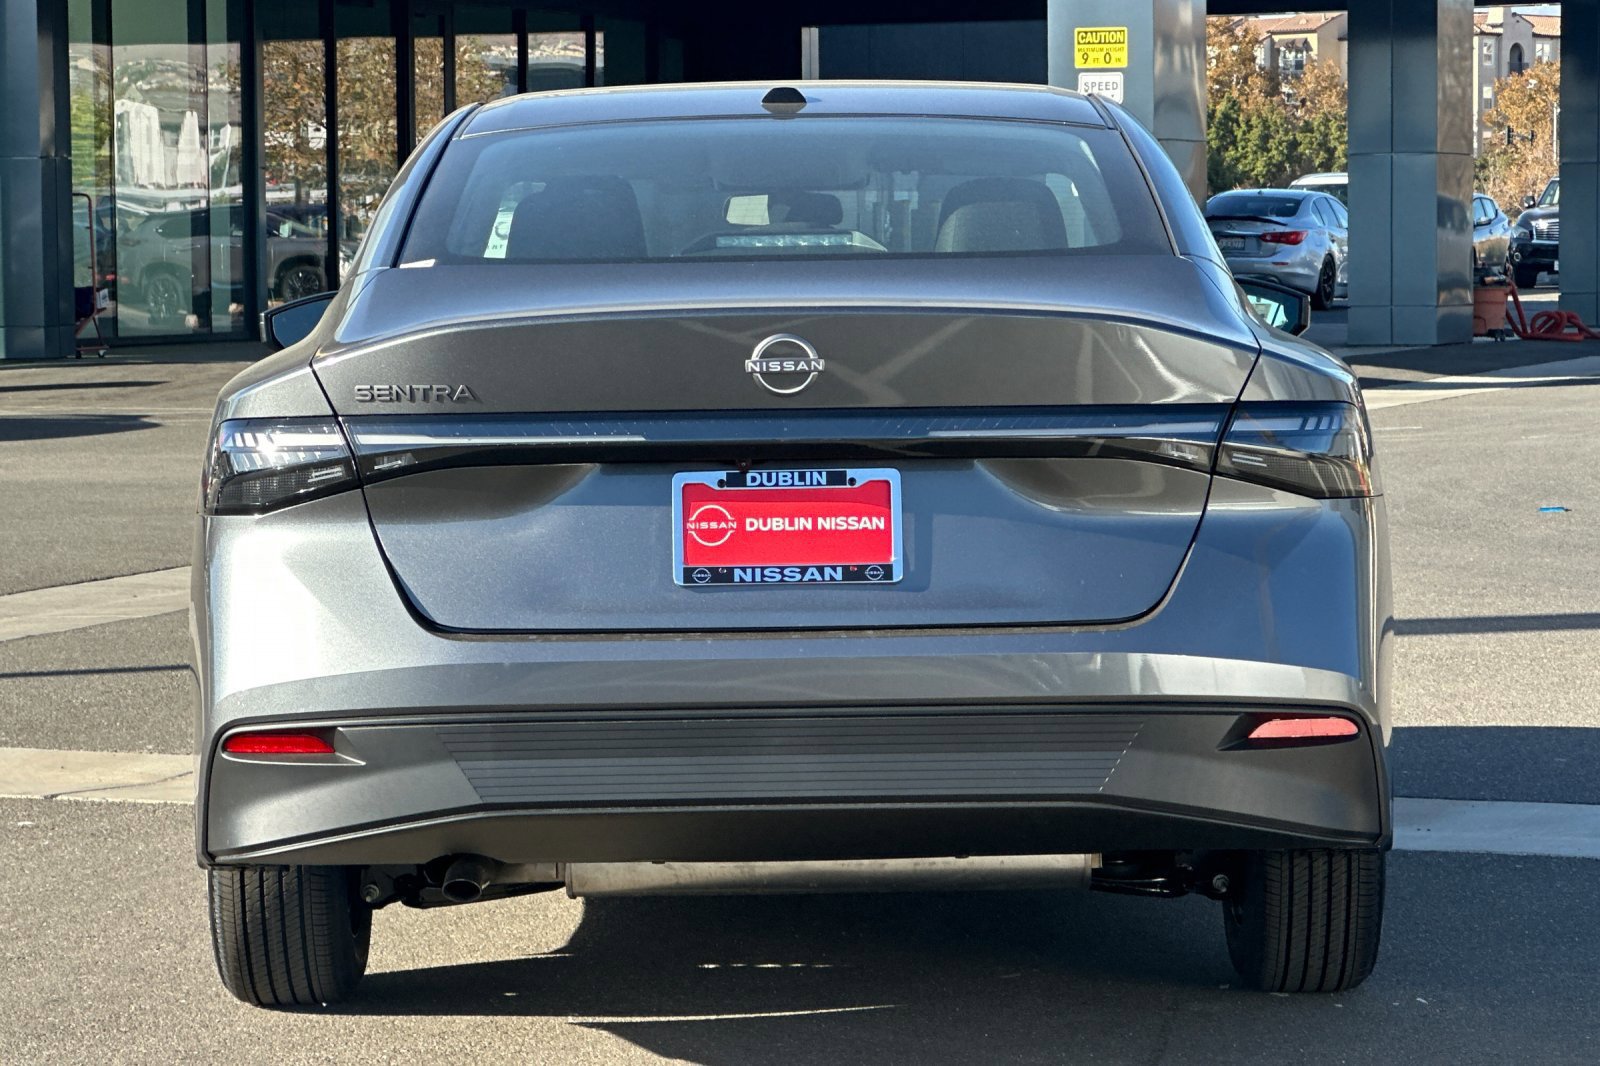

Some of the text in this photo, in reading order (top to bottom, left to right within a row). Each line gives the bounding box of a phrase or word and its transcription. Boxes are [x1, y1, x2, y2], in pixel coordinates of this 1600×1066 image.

[1078, 31, 1124, 44] CAUTION
[1082, 52, 1089, 64] 9
[1104, 52, 1112, 64] 0
[1084, 81, 1119, 92] SPEED
[748, 360, 824, 372] NISSAN
[354, 384, 476, 401] SENTRA
[746, 471, 827, 487] DUBLIN
[686, 521, 737, 530] NISSAN
[745, 516, 885, 532] DUBLIN NISSAN
[733, 567, 843, 583] NISSAN
